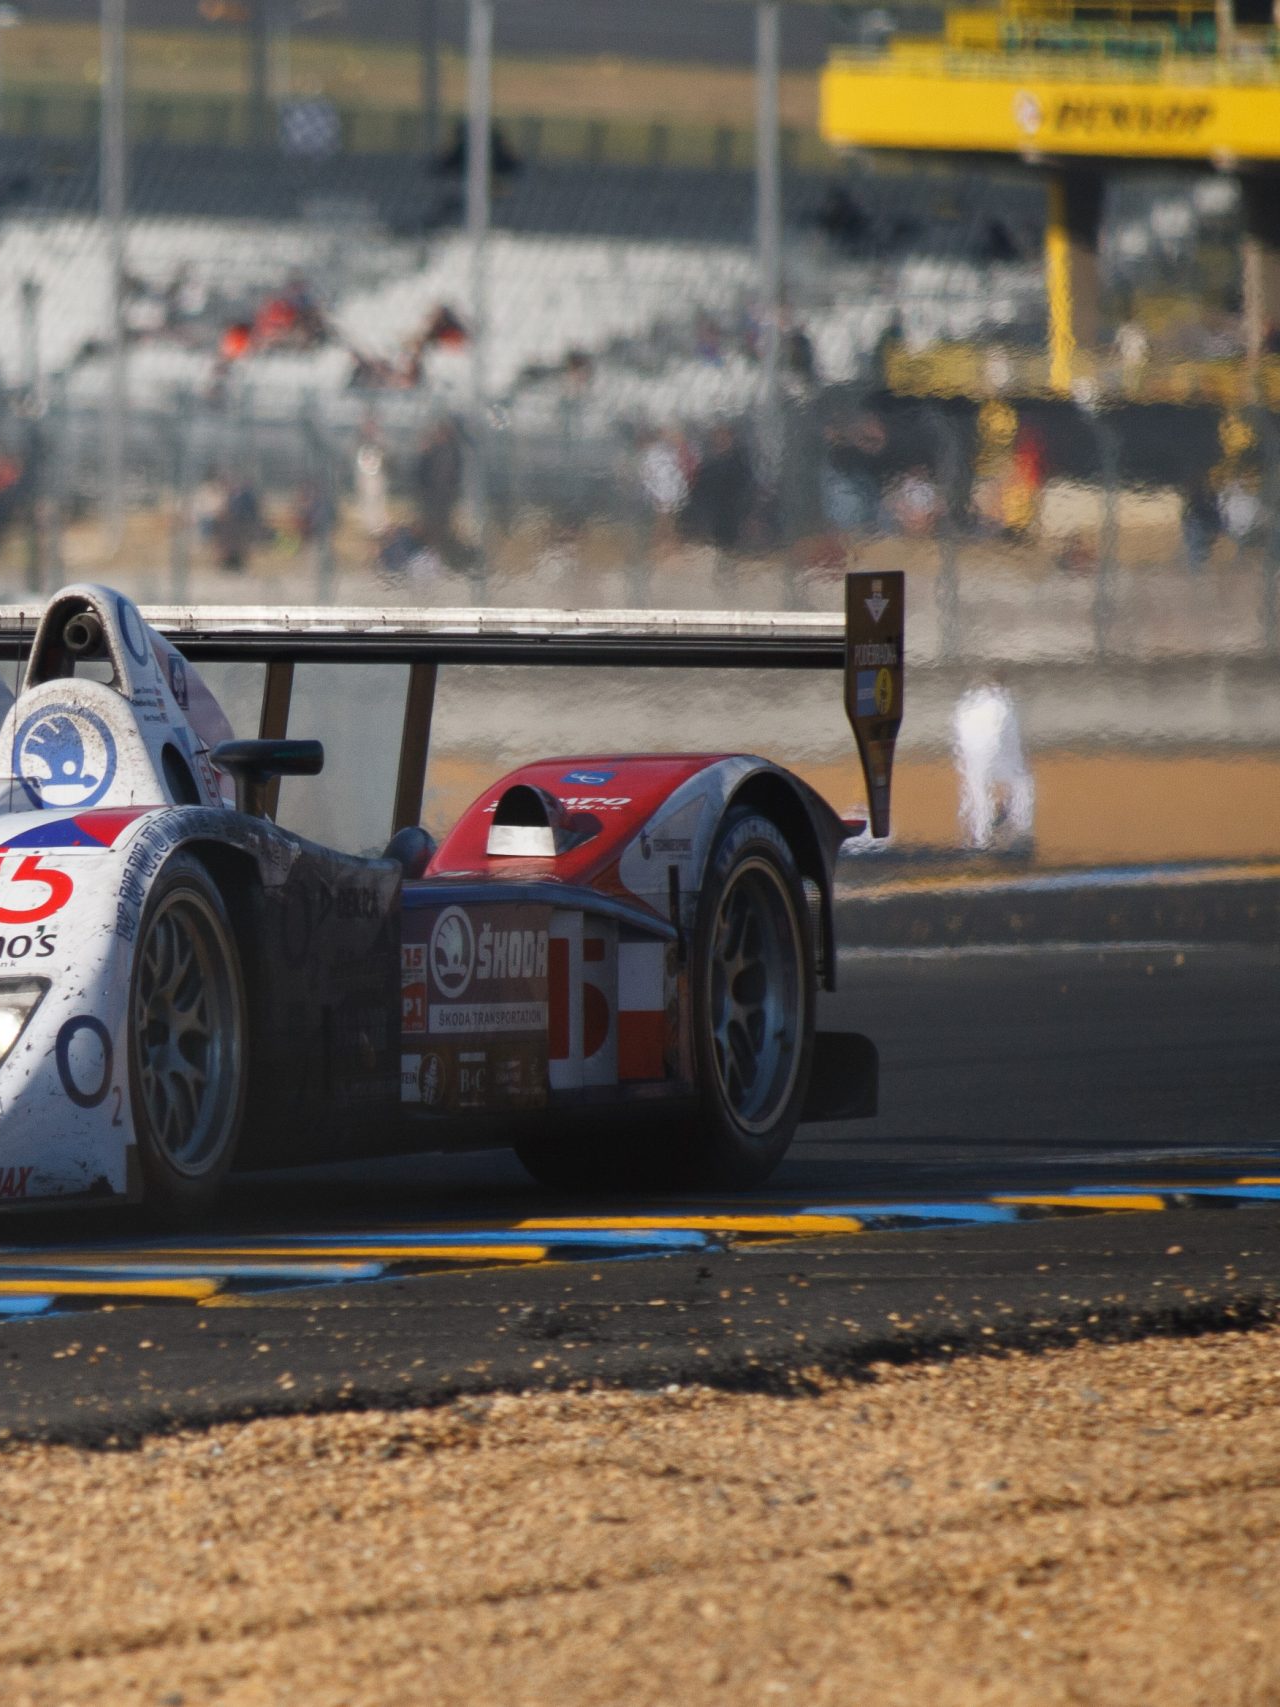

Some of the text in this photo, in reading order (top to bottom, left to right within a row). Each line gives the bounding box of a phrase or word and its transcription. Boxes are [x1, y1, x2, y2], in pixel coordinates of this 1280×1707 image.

[476, 922, 549, 980] ŠKODA
[438, 1009, 471, 1027] ŠKODA
[473, 1008, 543, 1025] TRANSPORTATION
